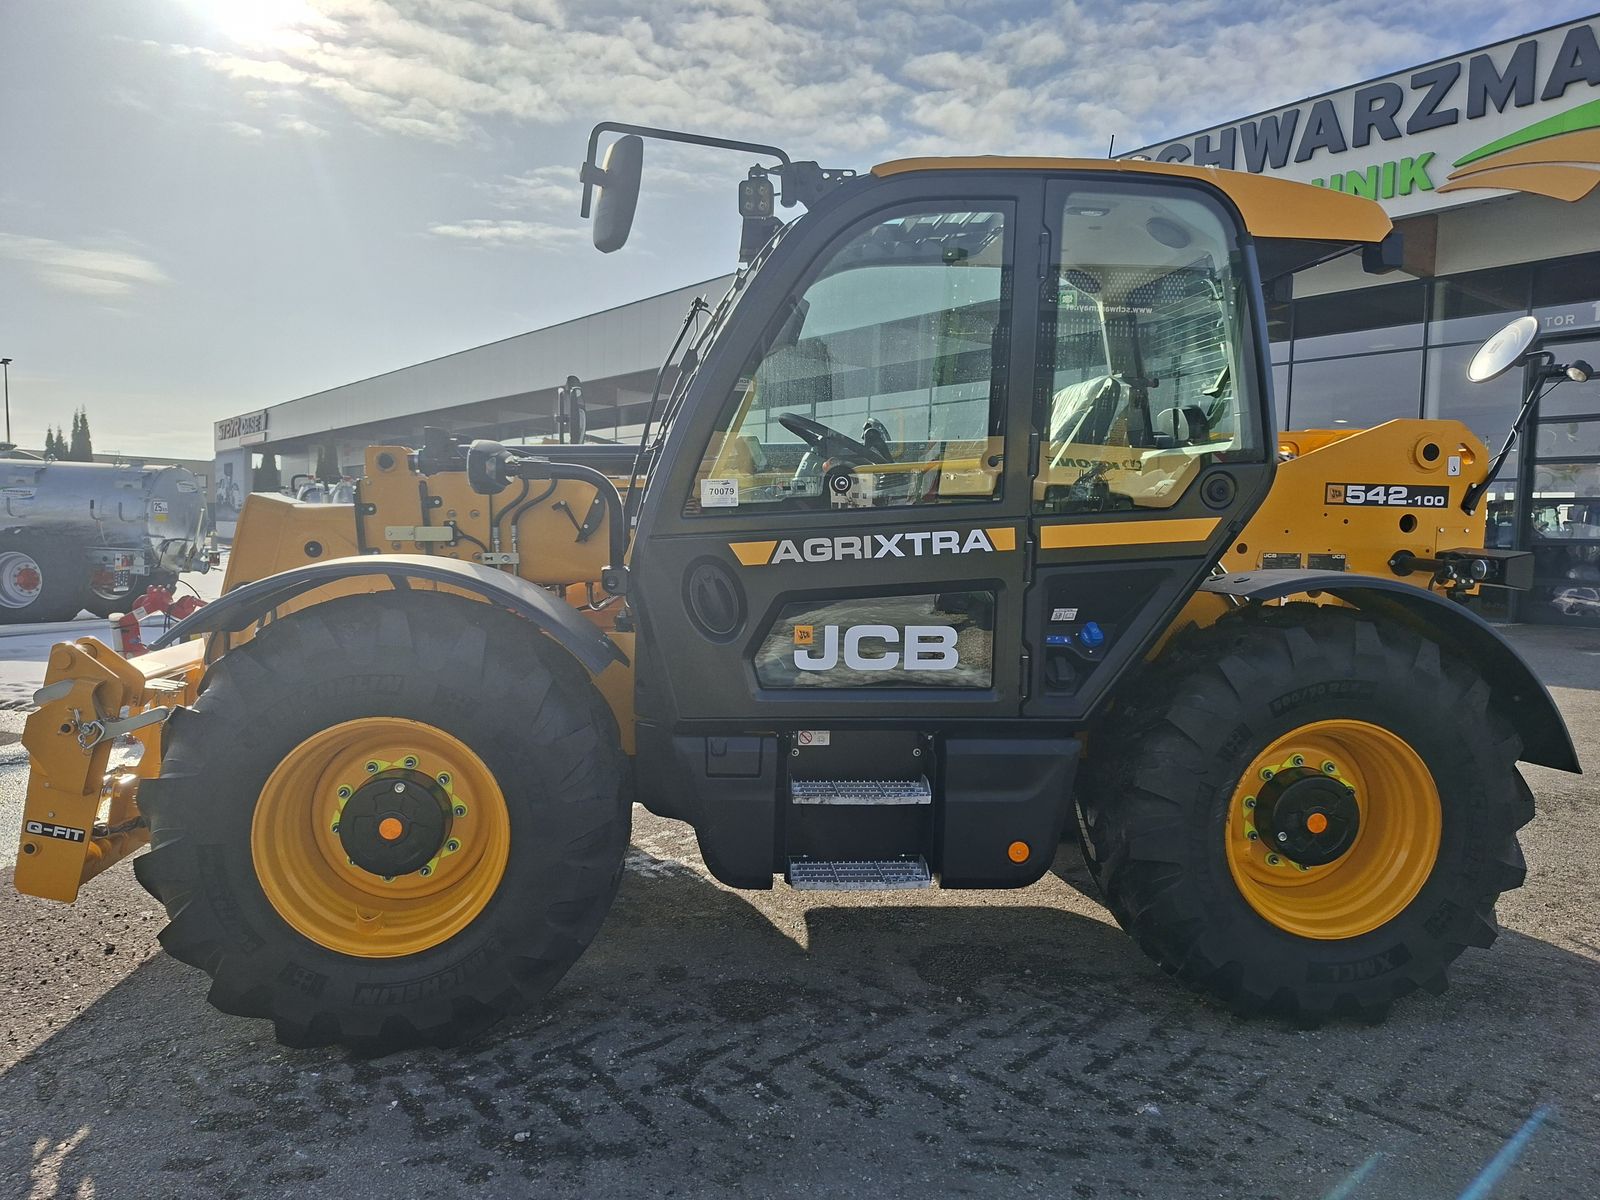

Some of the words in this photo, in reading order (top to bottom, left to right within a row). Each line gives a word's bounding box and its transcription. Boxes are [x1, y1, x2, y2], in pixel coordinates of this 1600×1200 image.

[1544, 314, 1575, 327] TOR
[709, 487, 735, 496] 70079
[1346, 485, 1445, 506] 542-100
[771, 529, 993, 564] AGRIXTRA
[794, 624, 959, 671] JCB
[26, 821, 84, 841] Q-FIT
